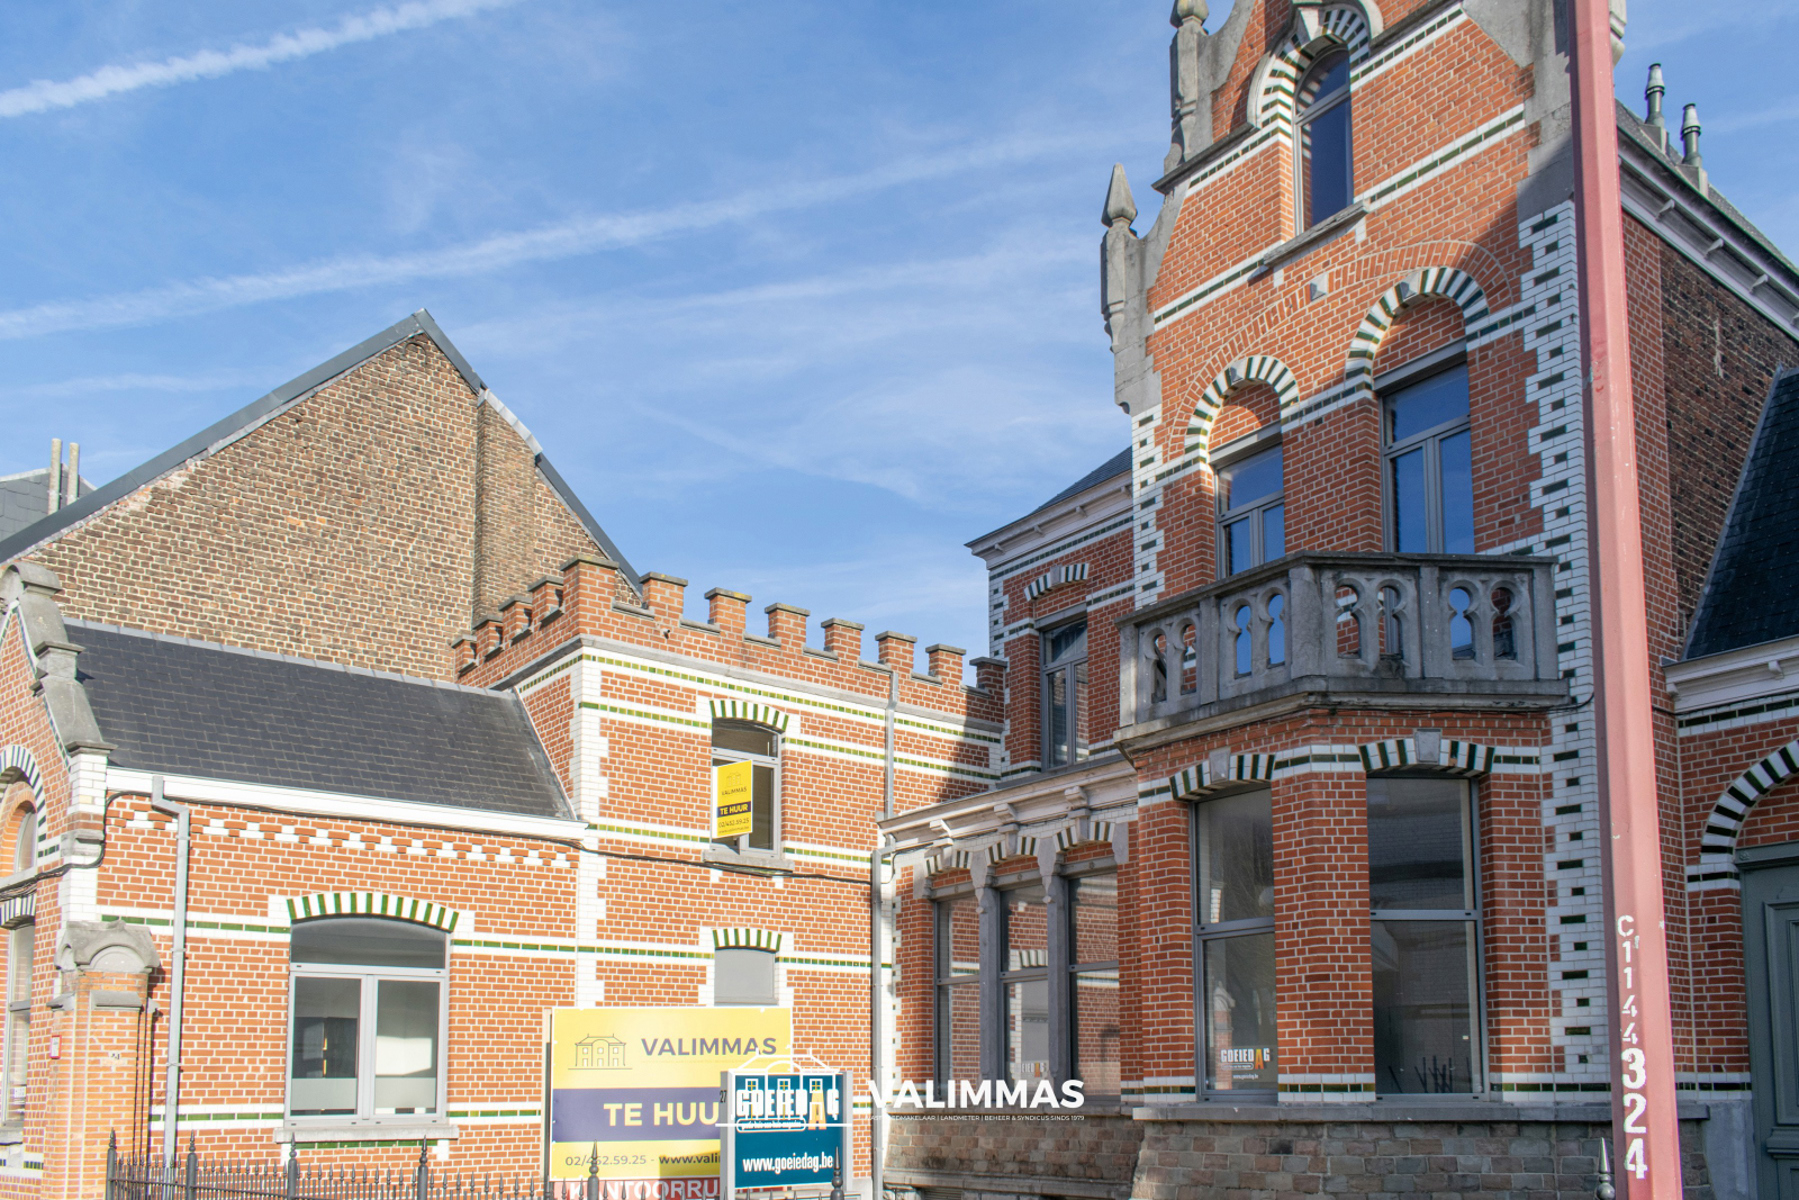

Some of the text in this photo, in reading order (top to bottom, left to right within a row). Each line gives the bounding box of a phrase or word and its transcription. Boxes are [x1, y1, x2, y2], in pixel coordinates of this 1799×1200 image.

[720, 803, 749, 815] TE HUUR
[641, 1036, 777, 1056] VALIMMAS
[1220, 1047, 1271, 1070] GOEIEDAG
[603, 1102, 643, 1127] TE
[653, 1101, 719, 1126] HUU
[742, 1151, 834, 1175] www.goeiedag.be
[569, 1179, 718, 1200] KNTOORRU
